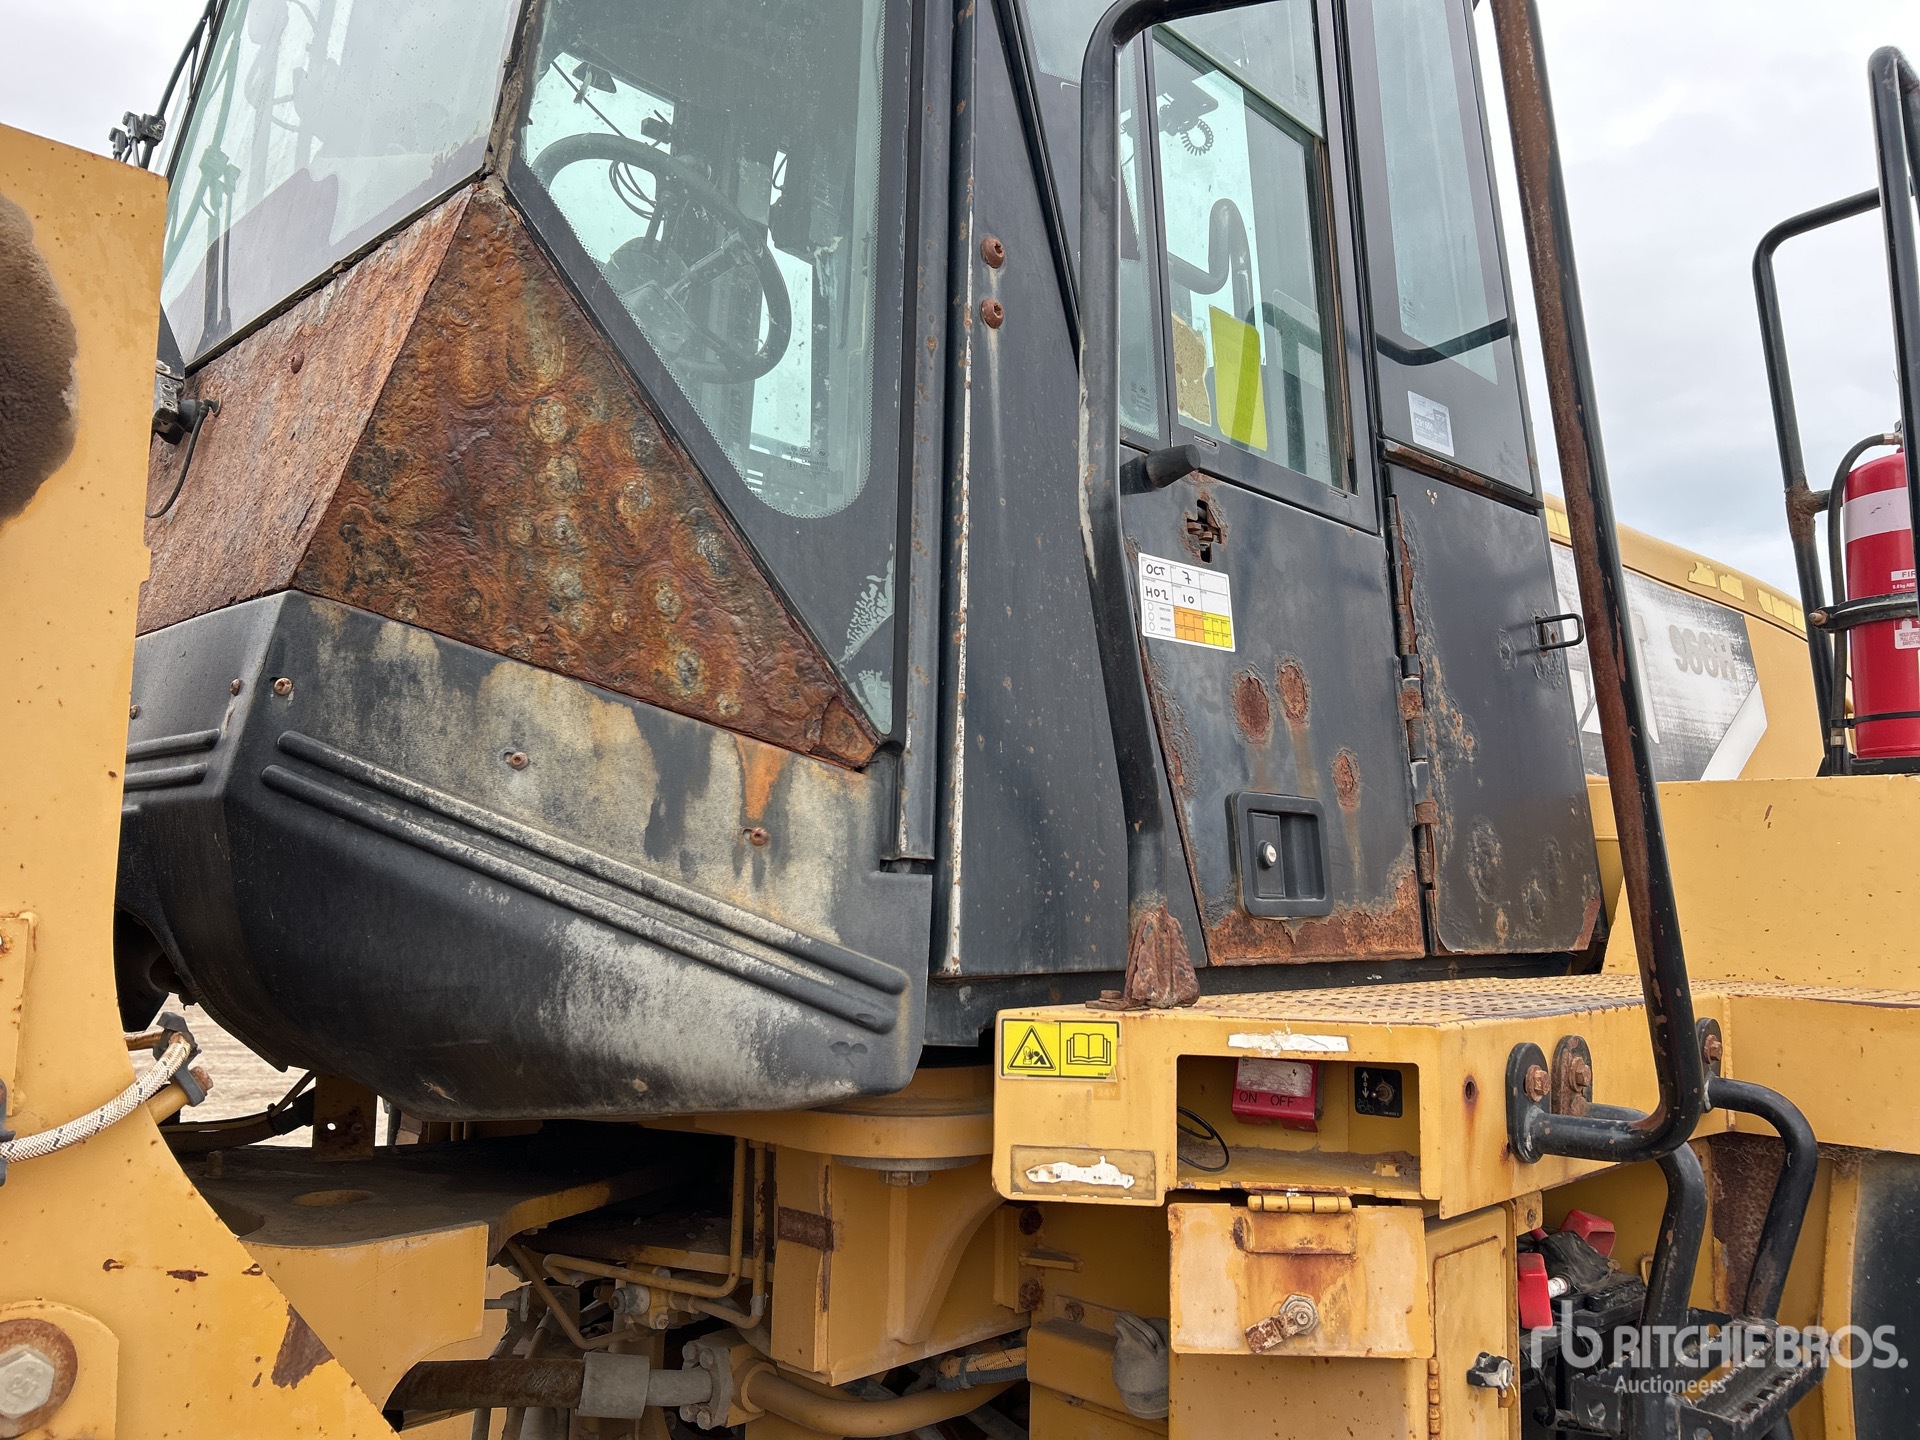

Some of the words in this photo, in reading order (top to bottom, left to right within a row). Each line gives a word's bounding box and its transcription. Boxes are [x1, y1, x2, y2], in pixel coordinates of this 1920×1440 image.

[1146, 564, 1165, 576] OCT
[1182, 570, 1191, 584] 7
[1183, 595, 1194, 604] 10
[1239, 1091, 1258, 1104] ON
[1270, 1094, 1296, 1107] OFF
